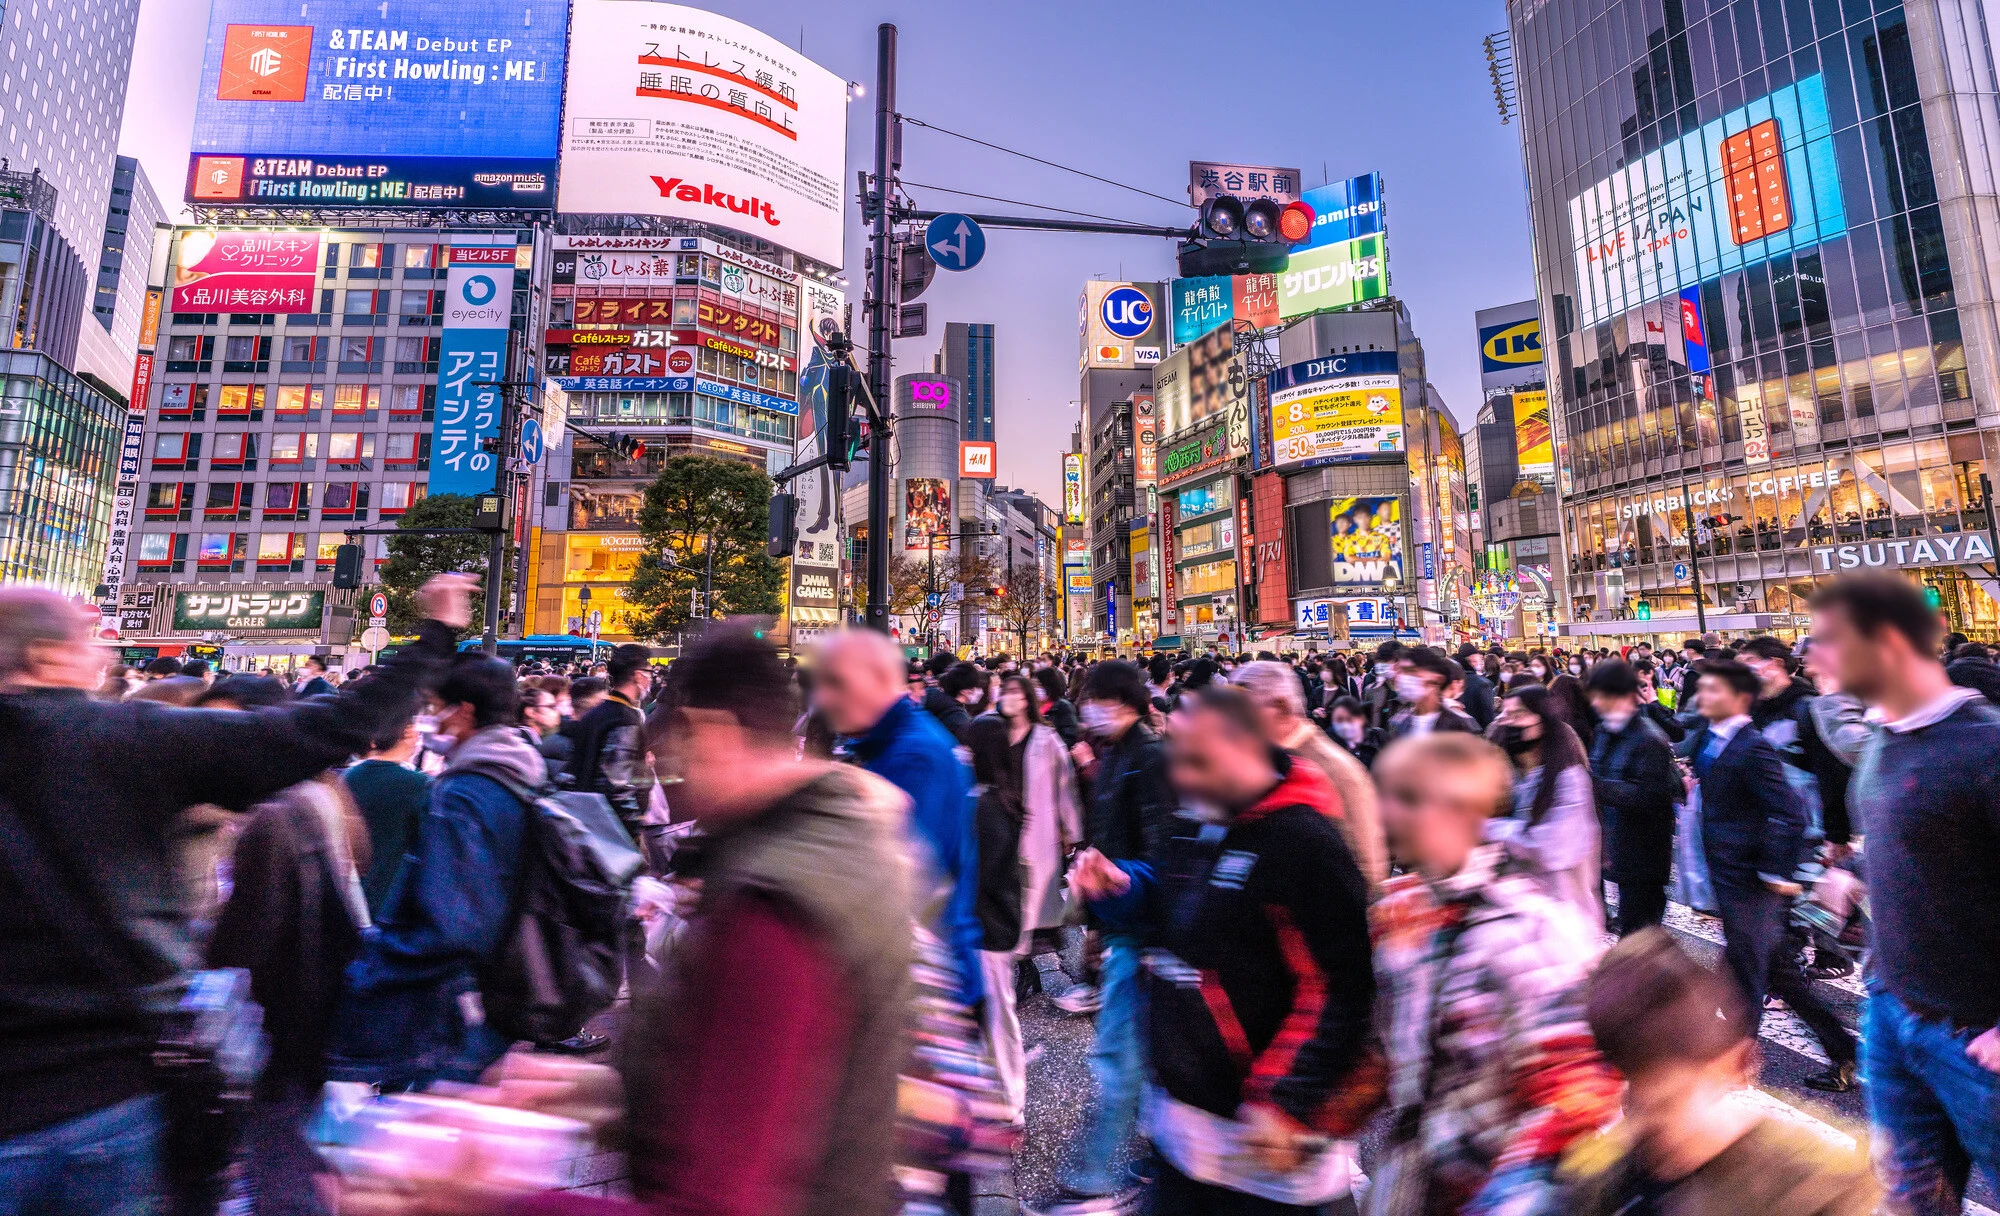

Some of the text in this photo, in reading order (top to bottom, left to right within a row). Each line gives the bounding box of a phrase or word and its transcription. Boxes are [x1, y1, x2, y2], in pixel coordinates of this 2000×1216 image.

[329, 29, 512, 53] &TEAM Debut EP
[250, 47, 282, 77] ME
[394, 59, 486, 85] Howling
[642, 41, 796, 105] ストレス緩和
[639, 72, 793, 133] 睡眠の質向上
[253, 158, 388, 177] &TEAM Debut EP
[474, 172, 545, 184] amazon music
[300, 180, 368, 201] Howling
[1200, 168, 1292, 194] 渋谷駅前
[649, 175, 781, 227] Yakult
[1312, 199, 1380, 227] amitsu
[1588, 195, 1703, 264] LIVE JAPAN
[1647, 228, 1688, 253] TOKYO
[241, 239, 313, 253] 品川スキン
[568, 237, 671, 249] しゃぶしゃぶバイキング
[240, 254, 304, 267] クリニック
[456, 250, 509, 262] 当ビル5F
[716, 244, 799, 282] しゃぶしゃぶバイキング
[555, 262, 575, 274] 9F
[611, 259, 669, 277] しゃぶ葉
[192, 288, 306, 306] 品川美容外科
[748, 277, 796, 308] しゃぶ葉
[1184, 284, 1220, 307] 龍角散
[451, 308, 503, 322] eyecity
[576, 301, 669, 319] プライス
[1106, 299, 1150, 325] UC
[1180, 302, 1228, 324] ダイレクト
[699, 304, 778, 340] コンタクト
[572, 330, 679, 347] Caféレストラン ガスト
[1494, 331, 1541, 357] IK
[547, 355, 570, 369] 7F
[575, 355, 600, 366] Café
[602, 352, 661, 375] ガスト
[706, 337, 791, 371] Caféレストラン ガスト
[1136, 350, 1160, 360] VISA
[137, 356, 150, 385] 外貨両替
[1306, 357, 1347, 378] DHC
[584, 377, 669, 390] 英会話イーオン
[701, 382, 725, 394] AEON
[1156, 371, 1178, 391] &TEAM
[731, 388, 797, 412] 英会話イーオン
[910, 381, 950, 410] 109
[1227, 357, 1250, 452] もんじゃ
[1279, 391, 1295, 400] ハチペイ
[440, 351, 475, 472] アイシティ
[470, 351, 498, 472] コンタクトの
[122, 422, 142, 471] 加藤眼科
[969, 453, 988, 466] H&M
[1329, 455, 1352, 463] Channel
[1623, 469, 1841, 519] STARBUCKS COFFEE
[114, 510, 129, 527] 内科
[109, 529, 127, 564] 産婦人科
[600, 536, 650, 546] L'OCCITA
[1164, 513, 1173, 582] ウィンターフルーツギフト
[1259, 528, 1282, 583] クスリ
[1814, 535, 1993, 570] TSUTAYA
[107, 564, 121, 601] 心療内科
[801, 574, 830, 587] DMM
[123, 594, 154, 606] 薬 2F
[796, 586, 835, 599] GAMES
[120, 610, 152, 619] 処方せん
[187, 594, 311, 616] サンドラッグ
[1302, 602, 1398, 623] 大盛書店
[126, 619, 143, 628] 受付
[227, 617, 265, 627] CARER
